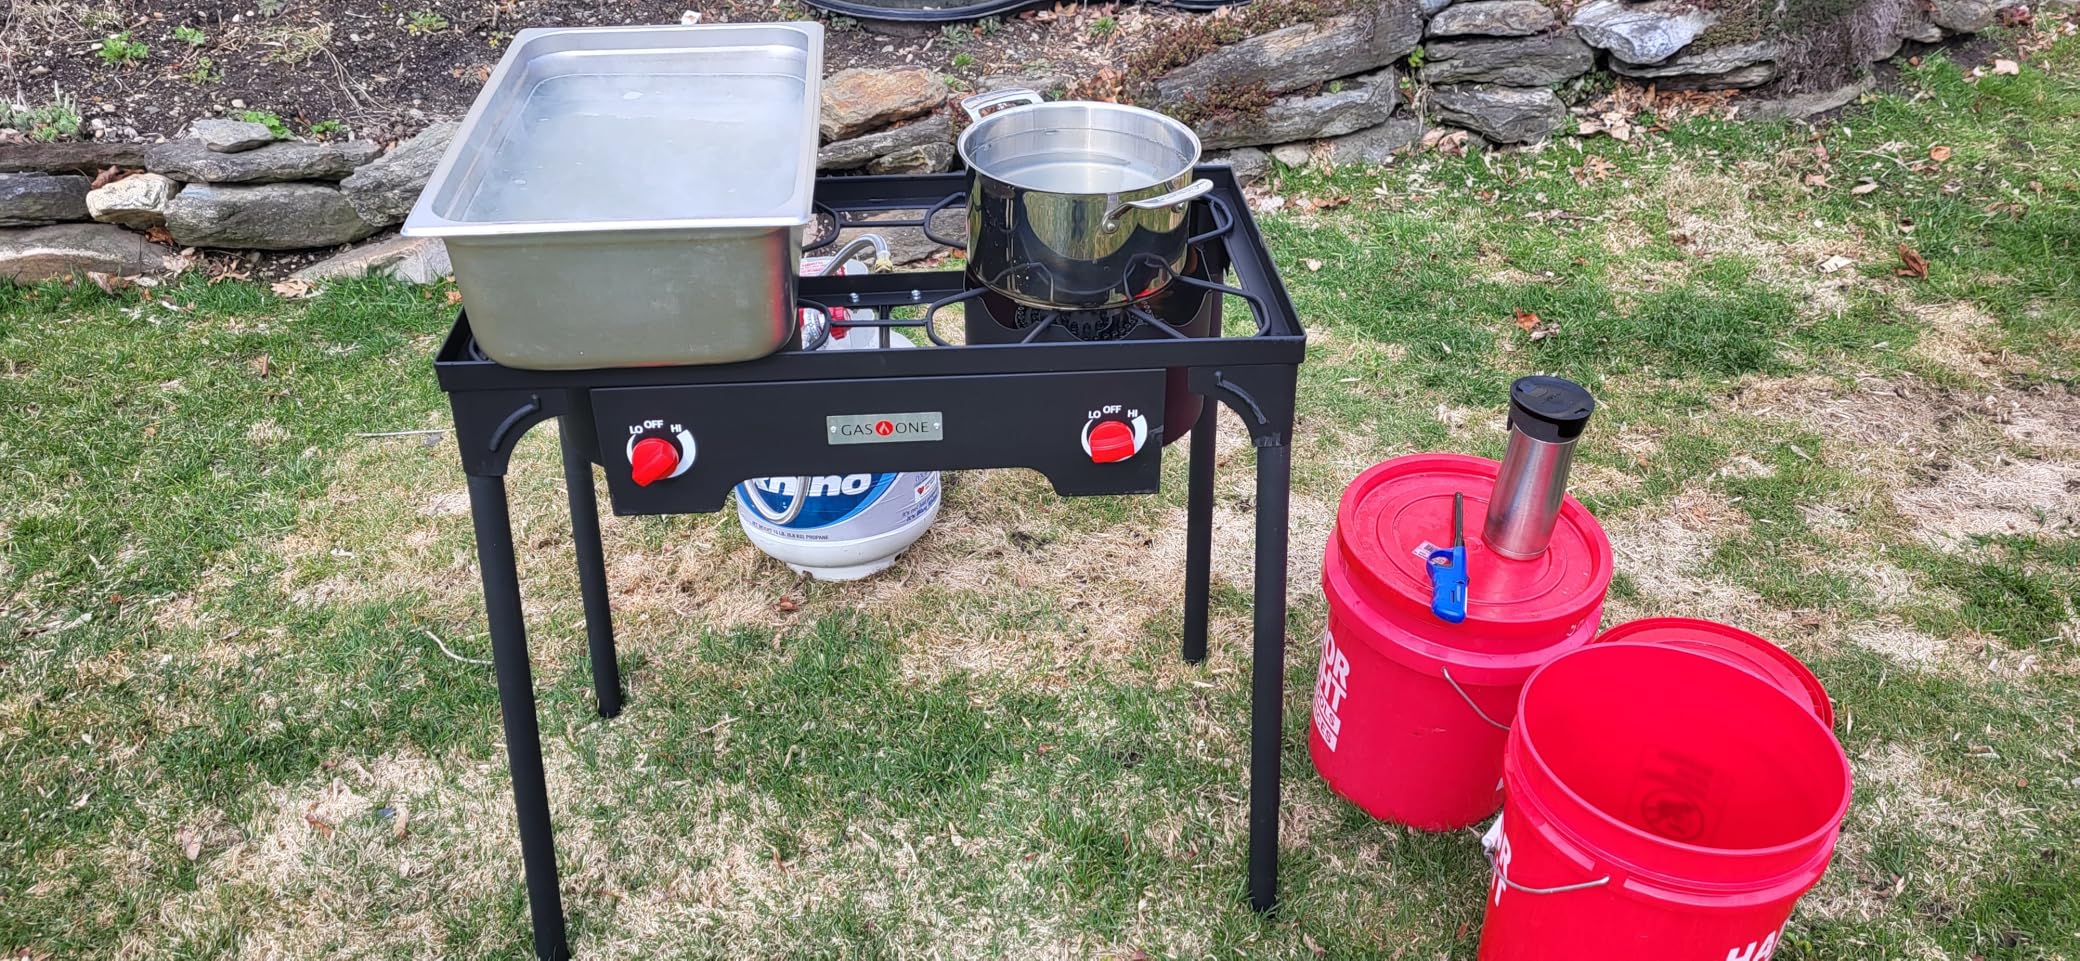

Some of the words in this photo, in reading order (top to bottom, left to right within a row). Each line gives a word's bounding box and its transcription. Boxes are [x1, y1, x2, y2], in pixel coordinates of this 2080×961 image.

[1087, 409, 1102, 419] LO
[1102, 404, 1122, 414] OFF
[1127, 408, 1138, 418] HI
[628, 425, 644, 434] LO
[643, 419, 664, 429] OFF
[670, 423, 682, 433] HI
[841, 423, 873, 436] GAS
[895, 421, 929, 434] ONE
